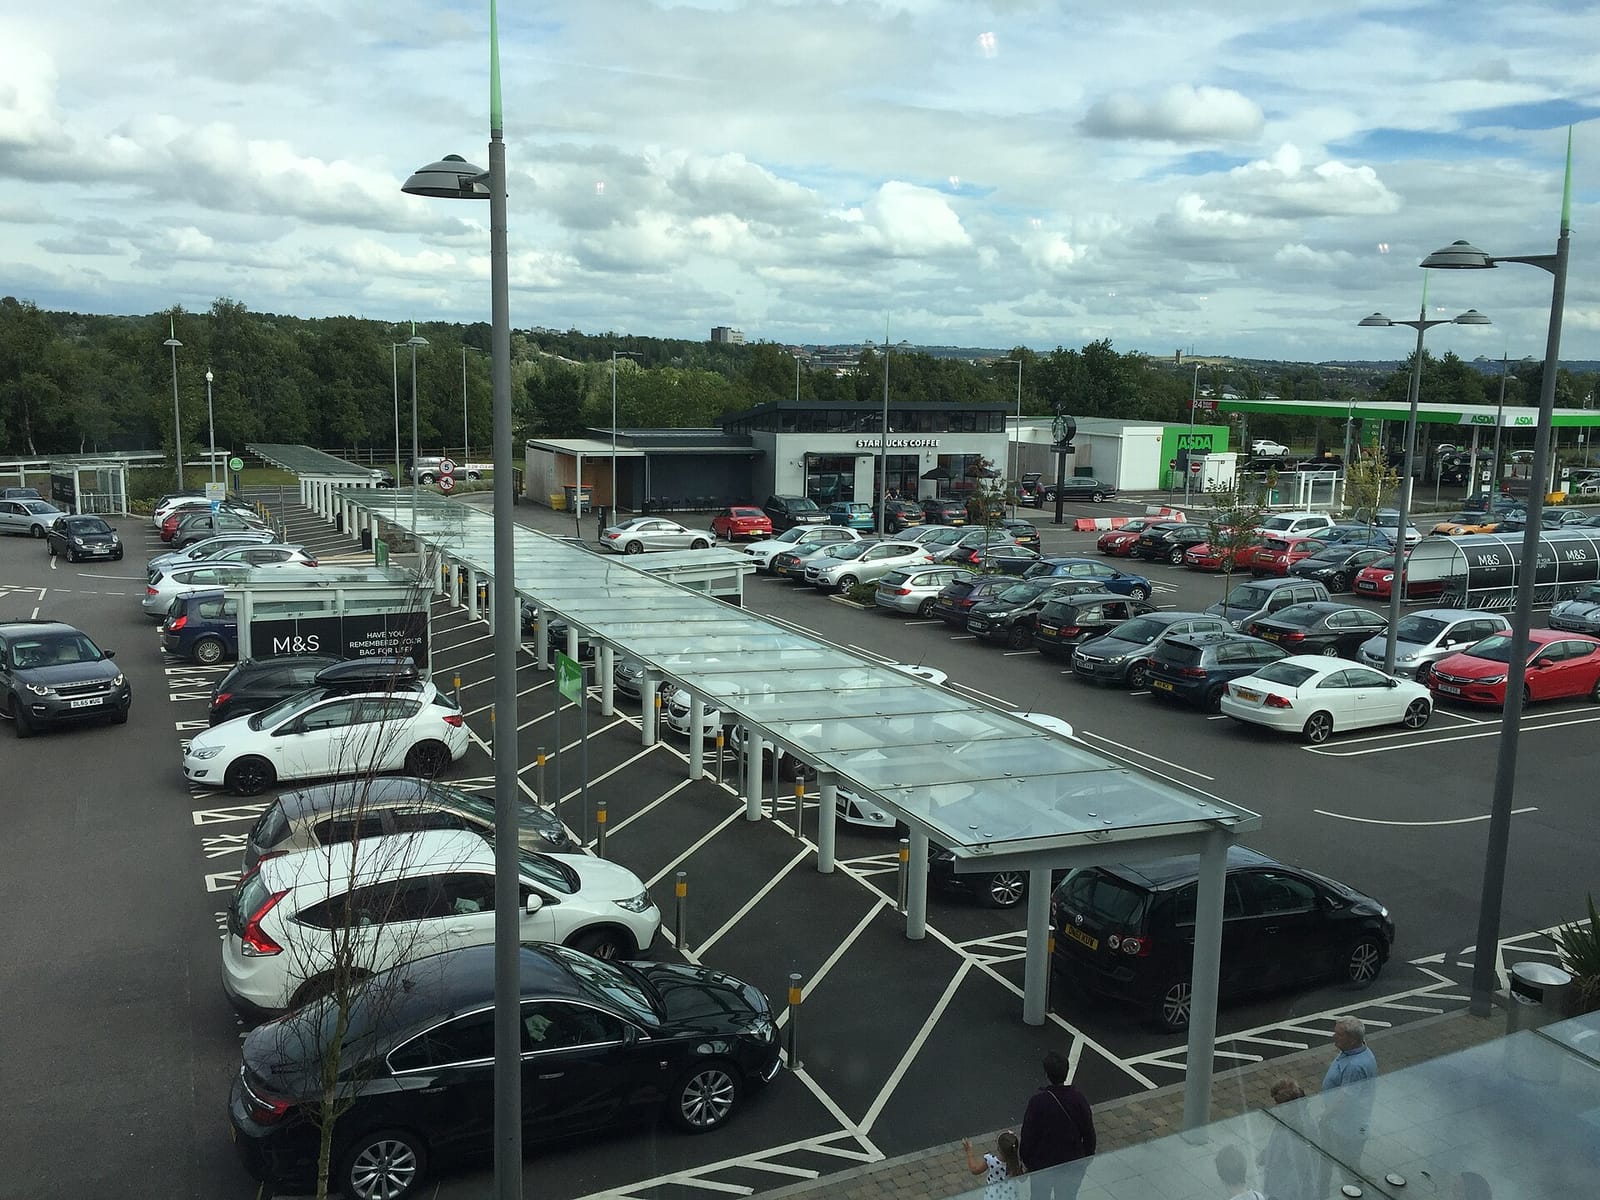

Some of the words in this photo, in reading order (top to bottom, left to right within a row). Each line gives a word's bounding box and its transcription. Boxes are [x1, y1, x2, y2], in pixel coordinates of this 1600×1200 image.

[1471, 415, 1496, 424] ASDA
[1514, 417, 1534, 425] ASDA
[857, 439, 908, 448] STARUCKS
[909, 439, 940, 448] COFFEE
[1178, 436, 1212, 449] ASDA
[1565, 549, 1587, 561] M&S
[1478, 554, 1500, 566] M&S
[366, 631, 386, 639] HAVE
[388, 630, 405, 638] YOU
[273, 634, 320, 654] M&S
[359, 648, 376, 656] BAG
[377, 647, 393, 655] FOR
